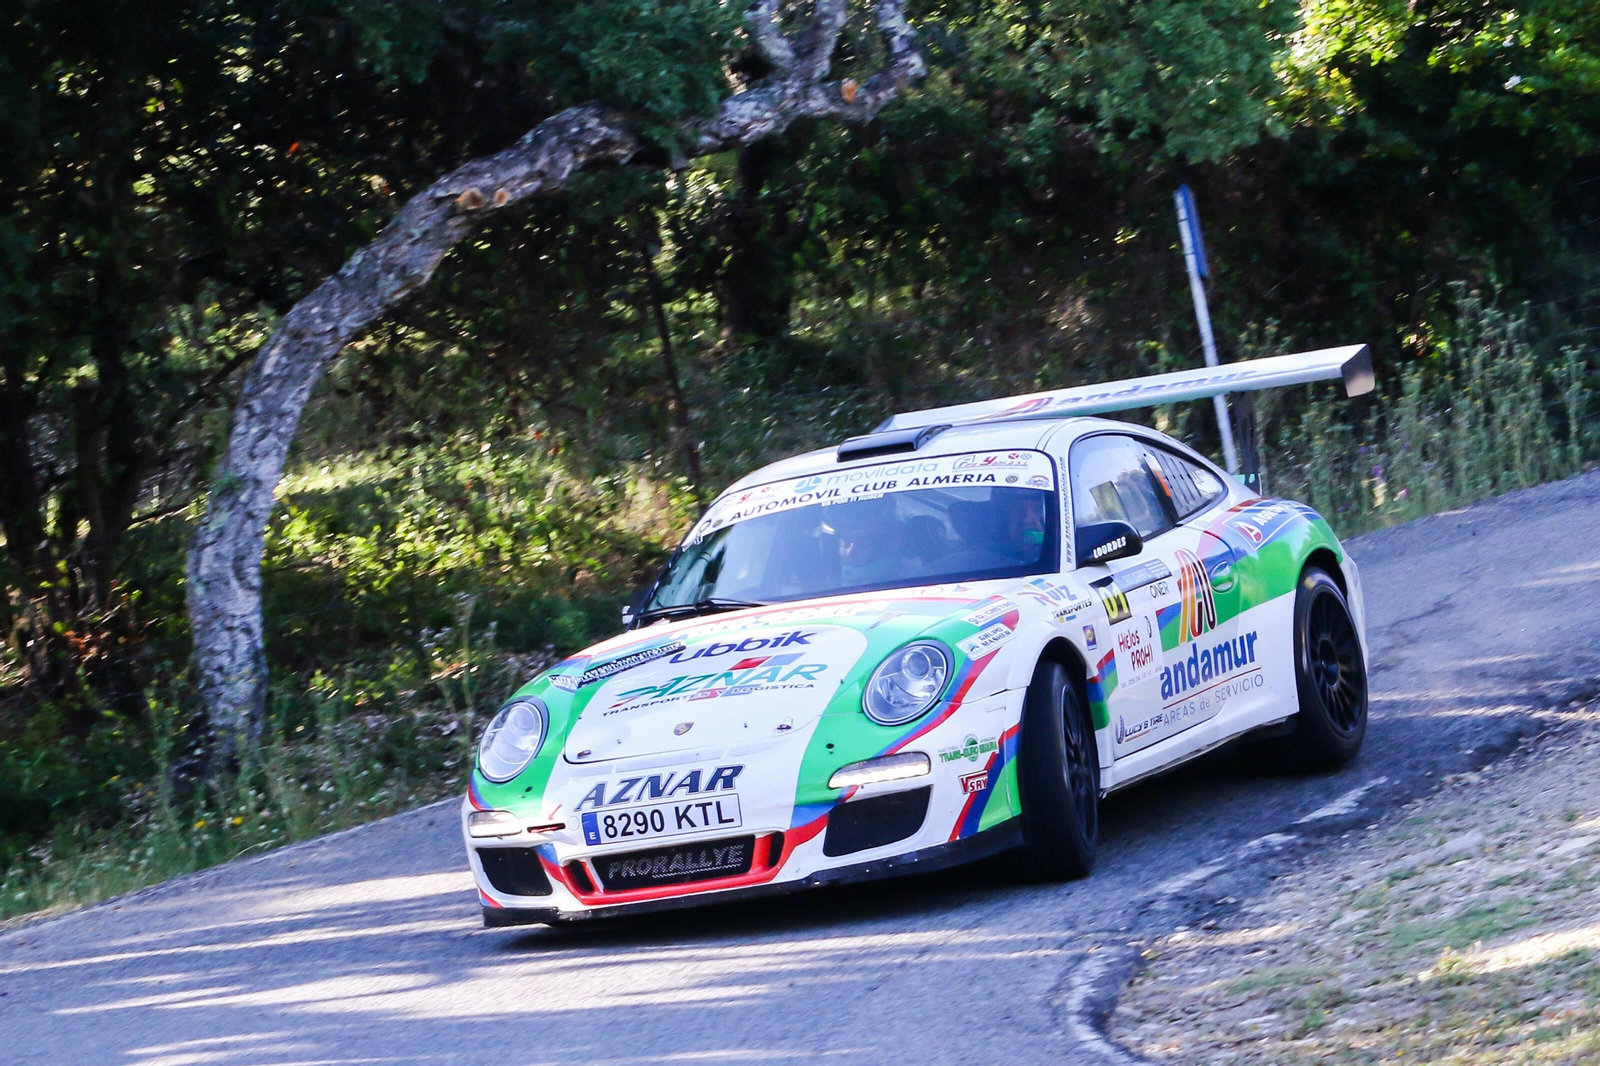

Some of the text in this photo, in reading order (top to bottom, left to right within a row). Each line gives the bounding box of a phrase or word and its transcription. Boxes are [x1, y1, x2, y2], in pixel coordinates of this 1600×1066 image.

[826, 461, 939, 486] movildata
[728, 487, 842, 523] AUTOMOVIL
[851, 480, 897, 494] CLUB
[906, 473, 997, 487] ALMERIA
[858, 493, 884, 502] RUBEN
[1093, 536, 1127, 559] LOURDES
[1033, 584, 1078, 606] RUIZ
[1051, 599, 1093, 619] TRANSPORTES
[669, 631, 818, 665] ubbik
[978, 627, 1004, 642] GRUPO
[614, 663, 828, 700] AZNAR
[1160, 630, 1258, 700] andamur
[602, 689, 714, 717] TRANSPORTES
[732, 683, 816, 694] LOGISTICA
[1162, 674, 1264, 727] AREAS de SERVICIO
[574, 764, 746, 812] AZNAR
[588, 831, 597, 841] E
[603, 801, 735, 839] 8290 KTL
[608, 844, 745, 879] PRORALLYE
